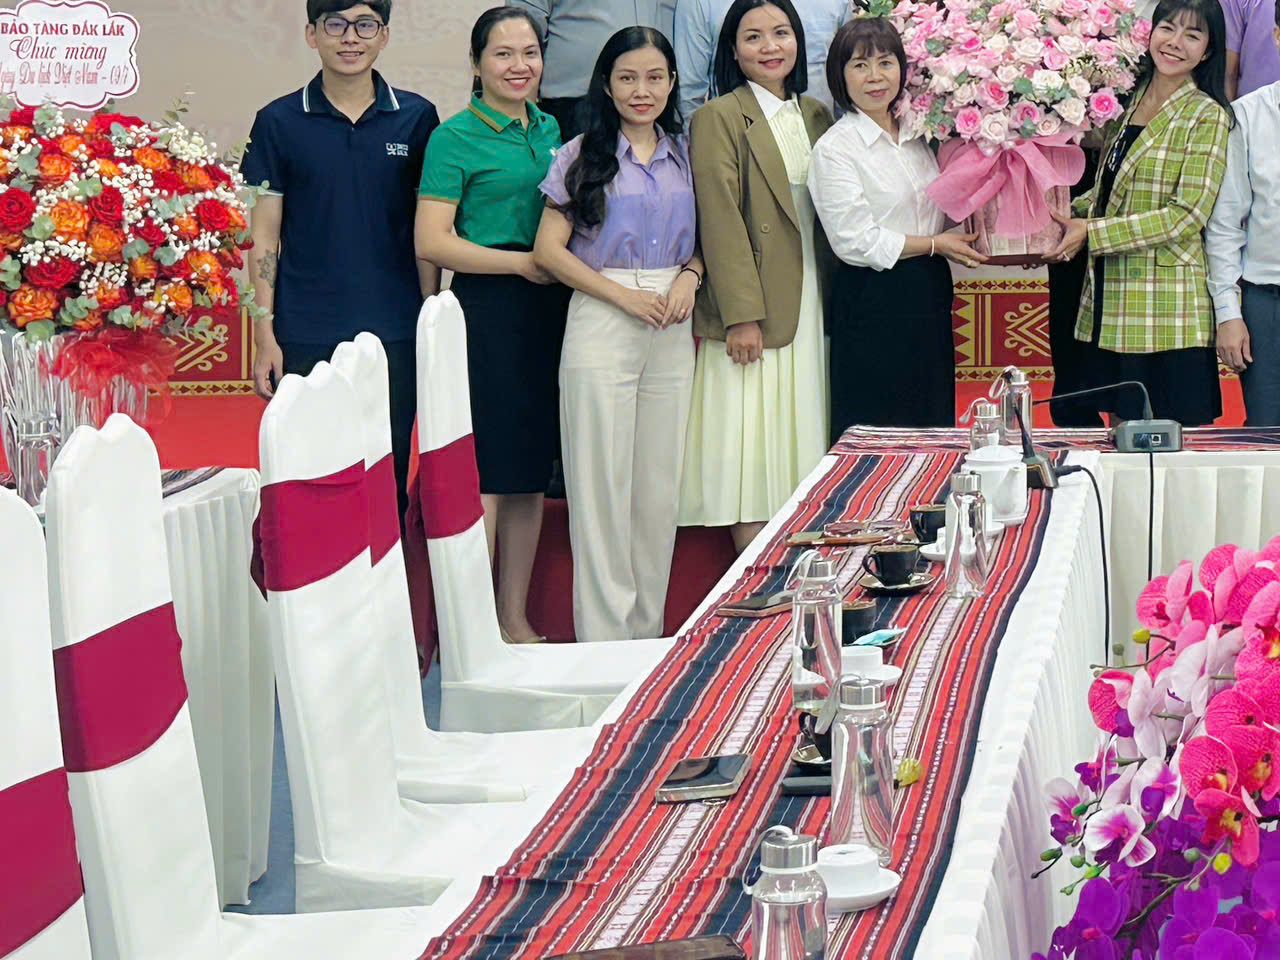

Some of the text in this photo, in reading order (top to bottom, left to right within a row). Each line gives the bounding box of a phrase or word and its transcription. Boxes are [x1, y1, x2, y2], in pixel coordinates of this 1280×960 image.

[1, 19, 125, 36] BẢO TÀNG ĐẮK LẮK
[9, 36, 57, 59] Chúc
